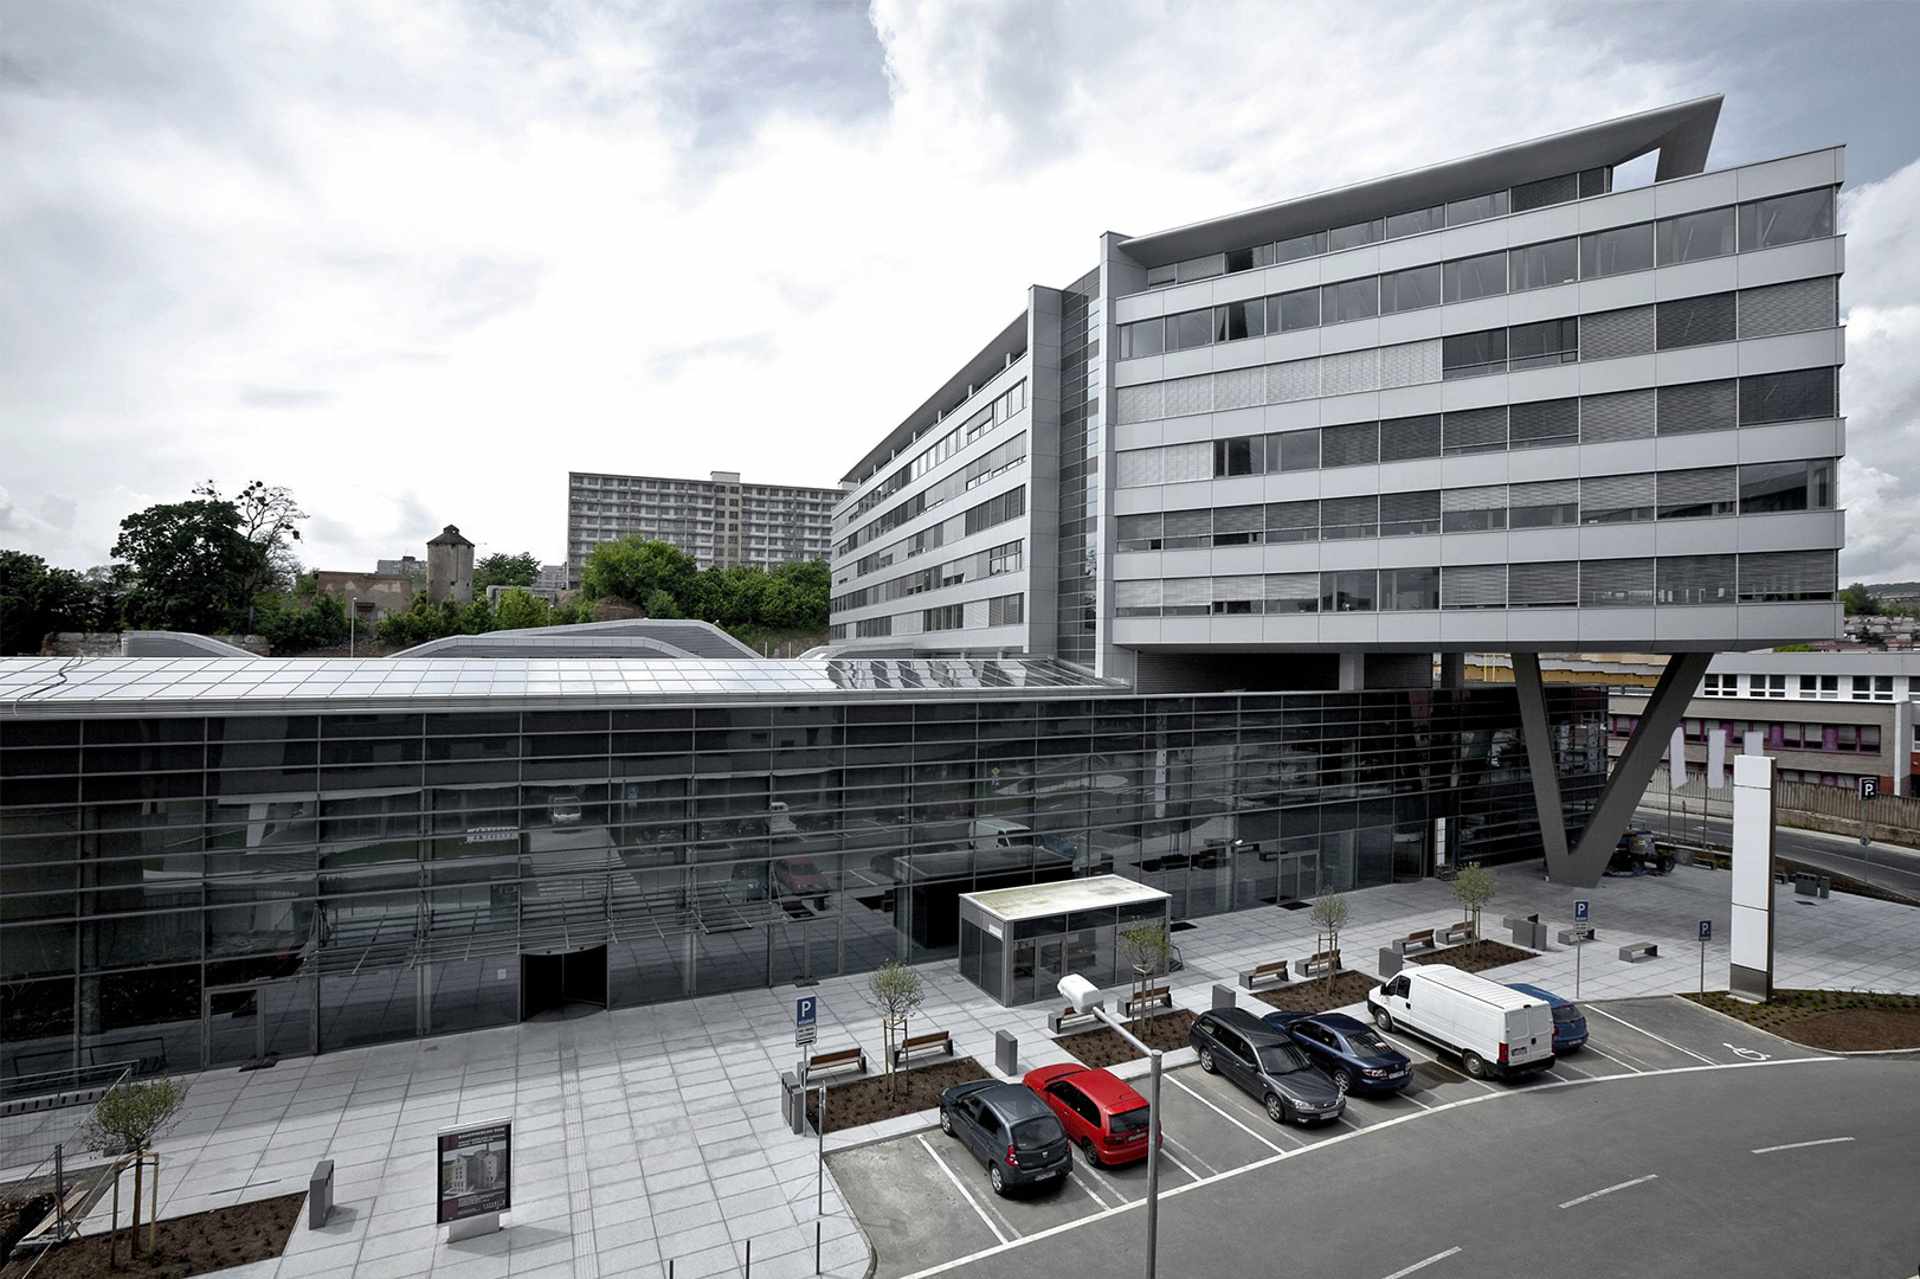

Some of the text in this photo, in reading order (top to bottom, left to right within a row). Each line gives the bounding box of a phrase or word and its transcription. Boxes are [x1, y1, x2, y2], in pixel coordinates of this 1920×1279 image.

[1578, 903, 1585, 916] P
[1702, 922, 1709, 935] P
[801, 1001, 811, 1017] P
